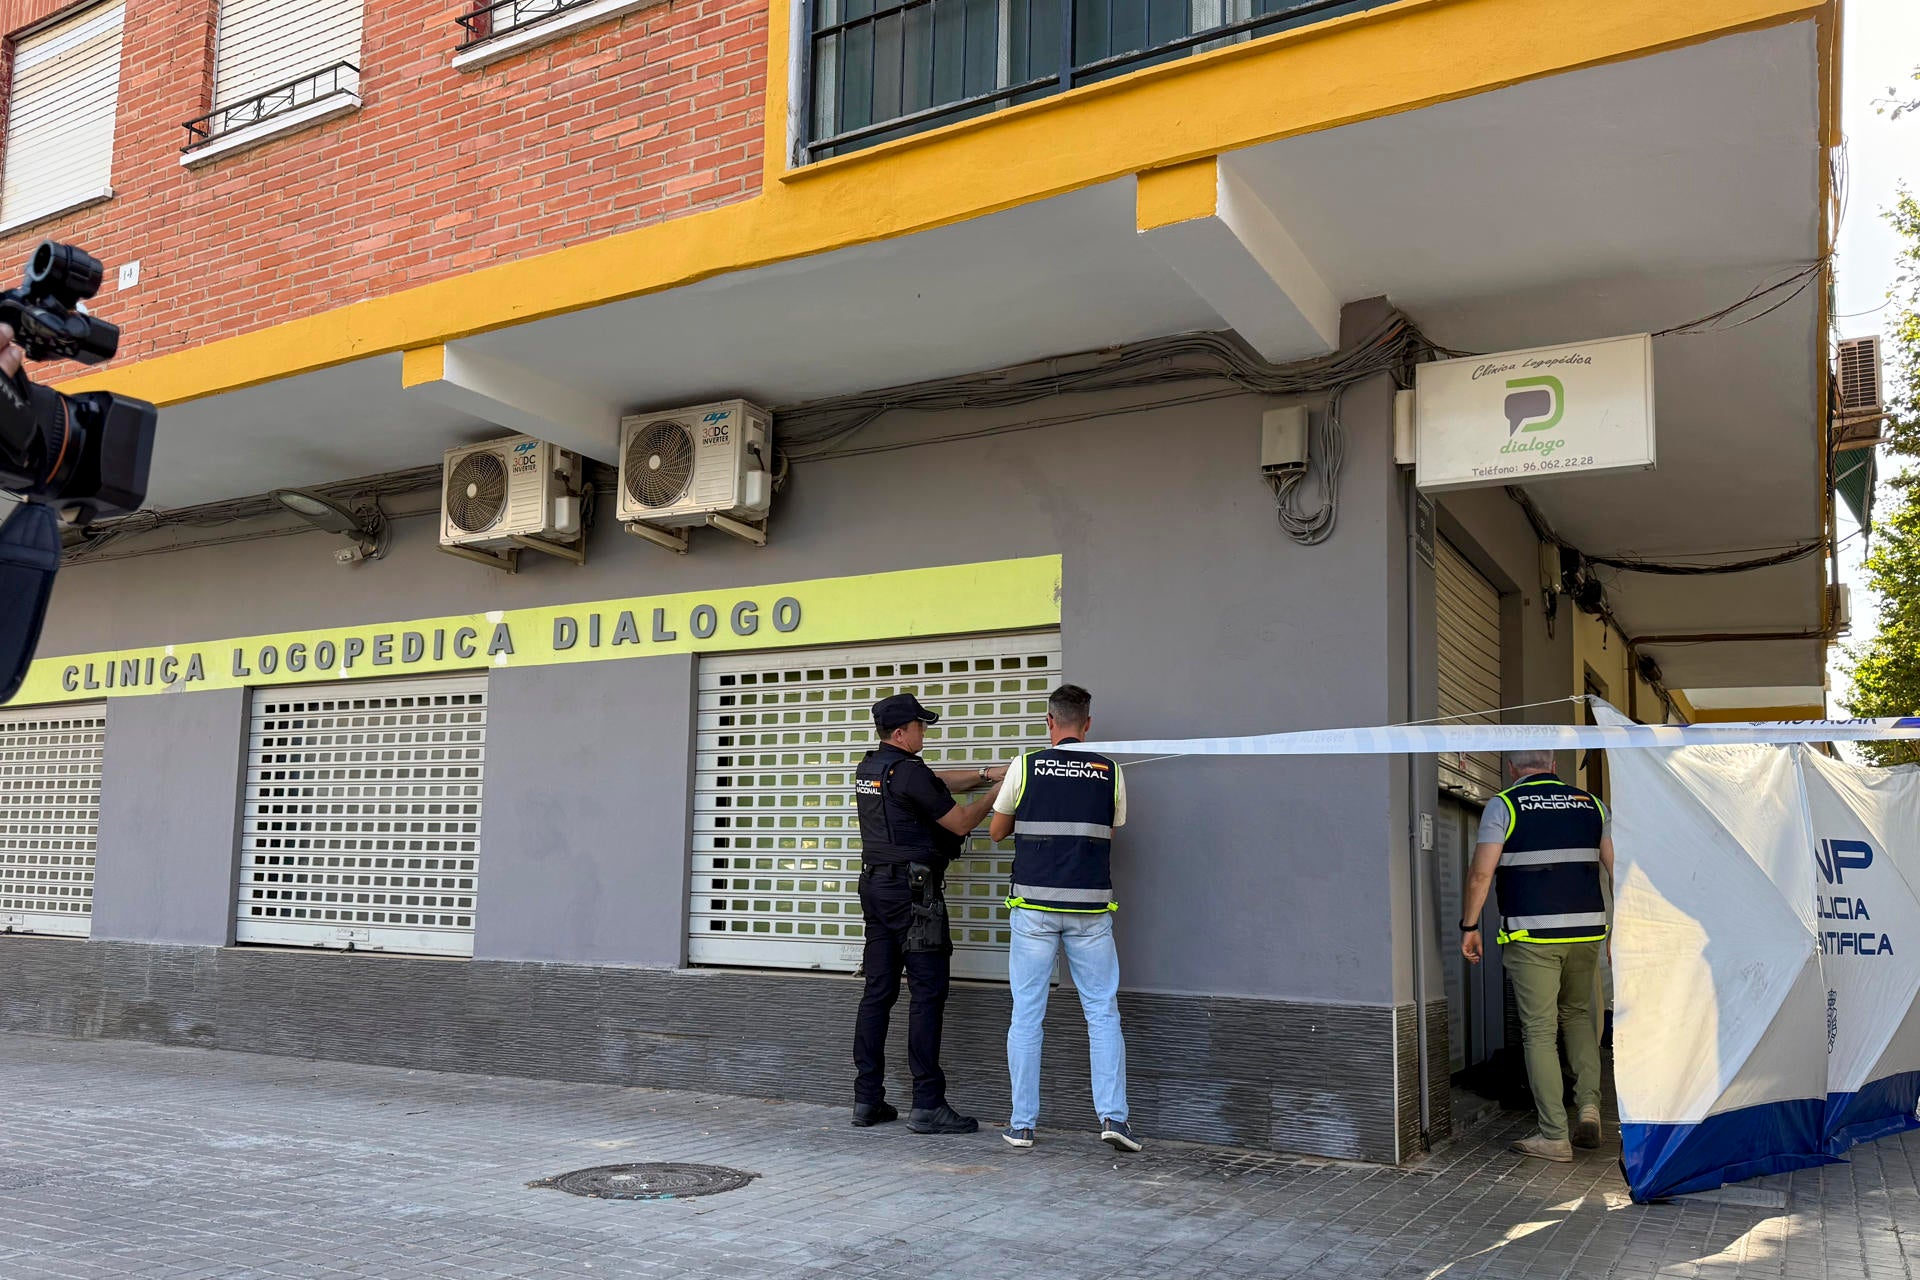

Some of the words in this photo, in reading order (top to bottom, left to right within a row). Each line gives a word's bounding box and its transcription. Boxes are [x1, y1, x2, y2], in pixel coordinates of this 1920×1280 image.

[1500, 436, 1565, 456] dialogo
[1472, 464, 1519, 476] Teléfono:
[1523, 456, 1594, 472] 96.062.22.28
[62, 652, 204, 691] CLINICA
[233, 622, 514, 676] LOGOPEDICA
[553, 596, 801, 650] DIALOGO
[1034, 759, 1093, 769] POLICIA
[1034, 767, 1109, 781] NACIONAL
[1518, 794, 1576, 803] POLICIA
[1521, 801, 1595, 812] NACIONAL
